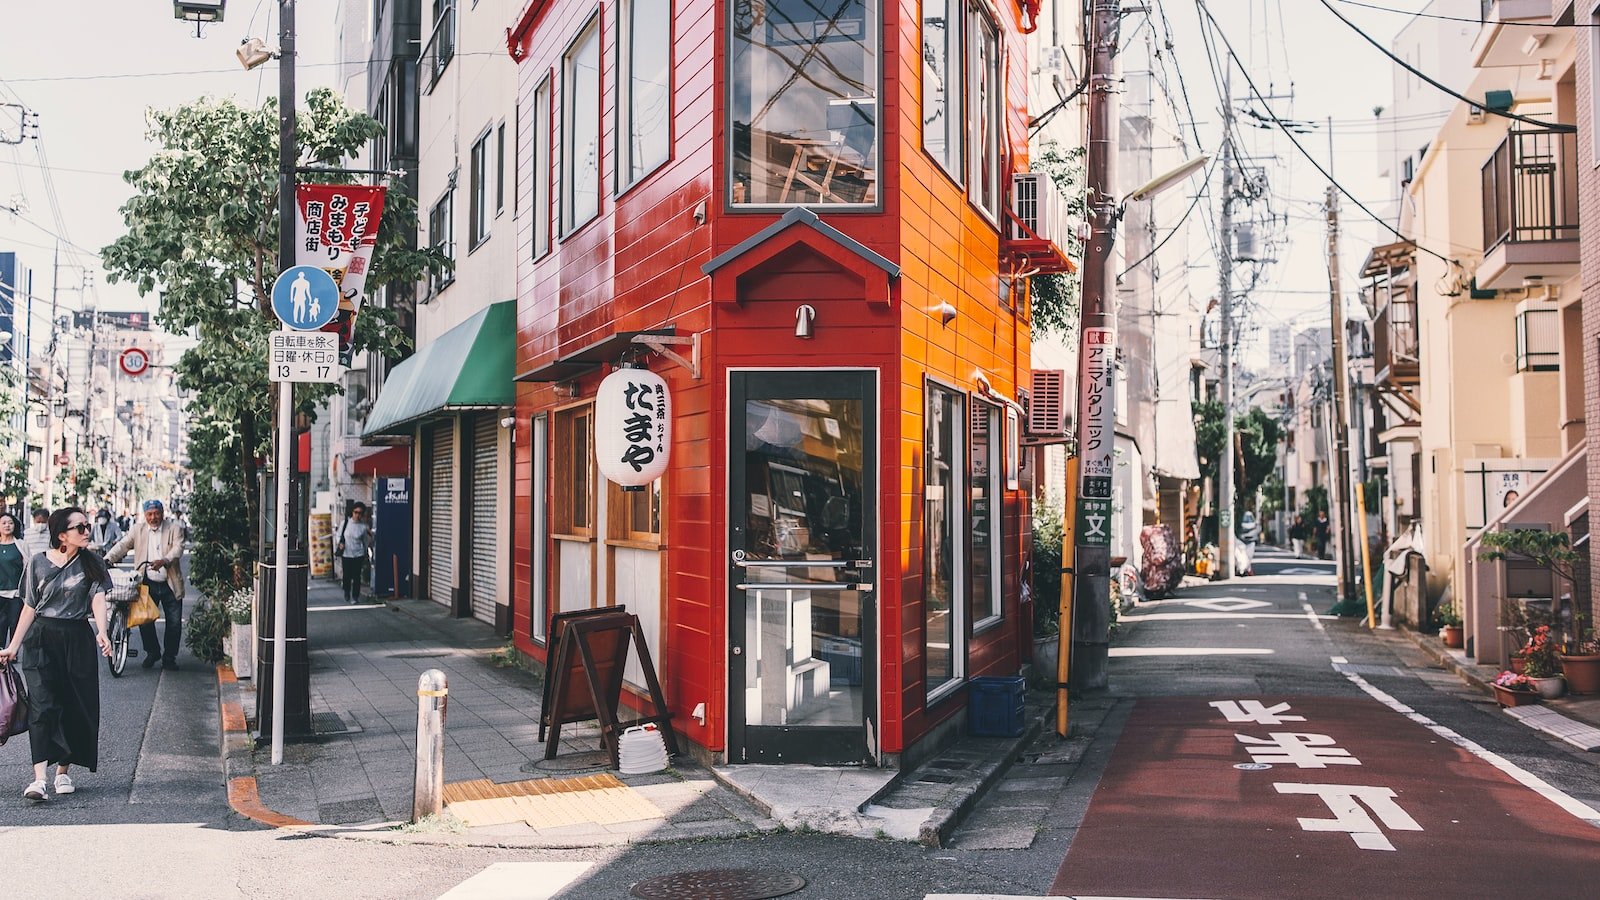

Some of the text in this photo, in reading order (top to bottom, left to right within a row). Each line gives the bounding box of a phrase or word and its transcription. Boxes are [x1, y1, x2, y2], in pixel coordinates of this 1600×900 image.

[305, 202, 324, 252] 商店街
[327, 195, 347, 260] みまもり
[349, 203, 369, 250] 子ども
[274, 335, 335, 349] 自転車を除く
[126, 355, 143, 368] 30
[274, 350, 335, 364] 日曜・休日の
[277, 365, 290, 378] 13
[317, 366, 330, 378] 17
[620, 381, 655, 473] たまや
[1084, 512, 1106, 537] 文
